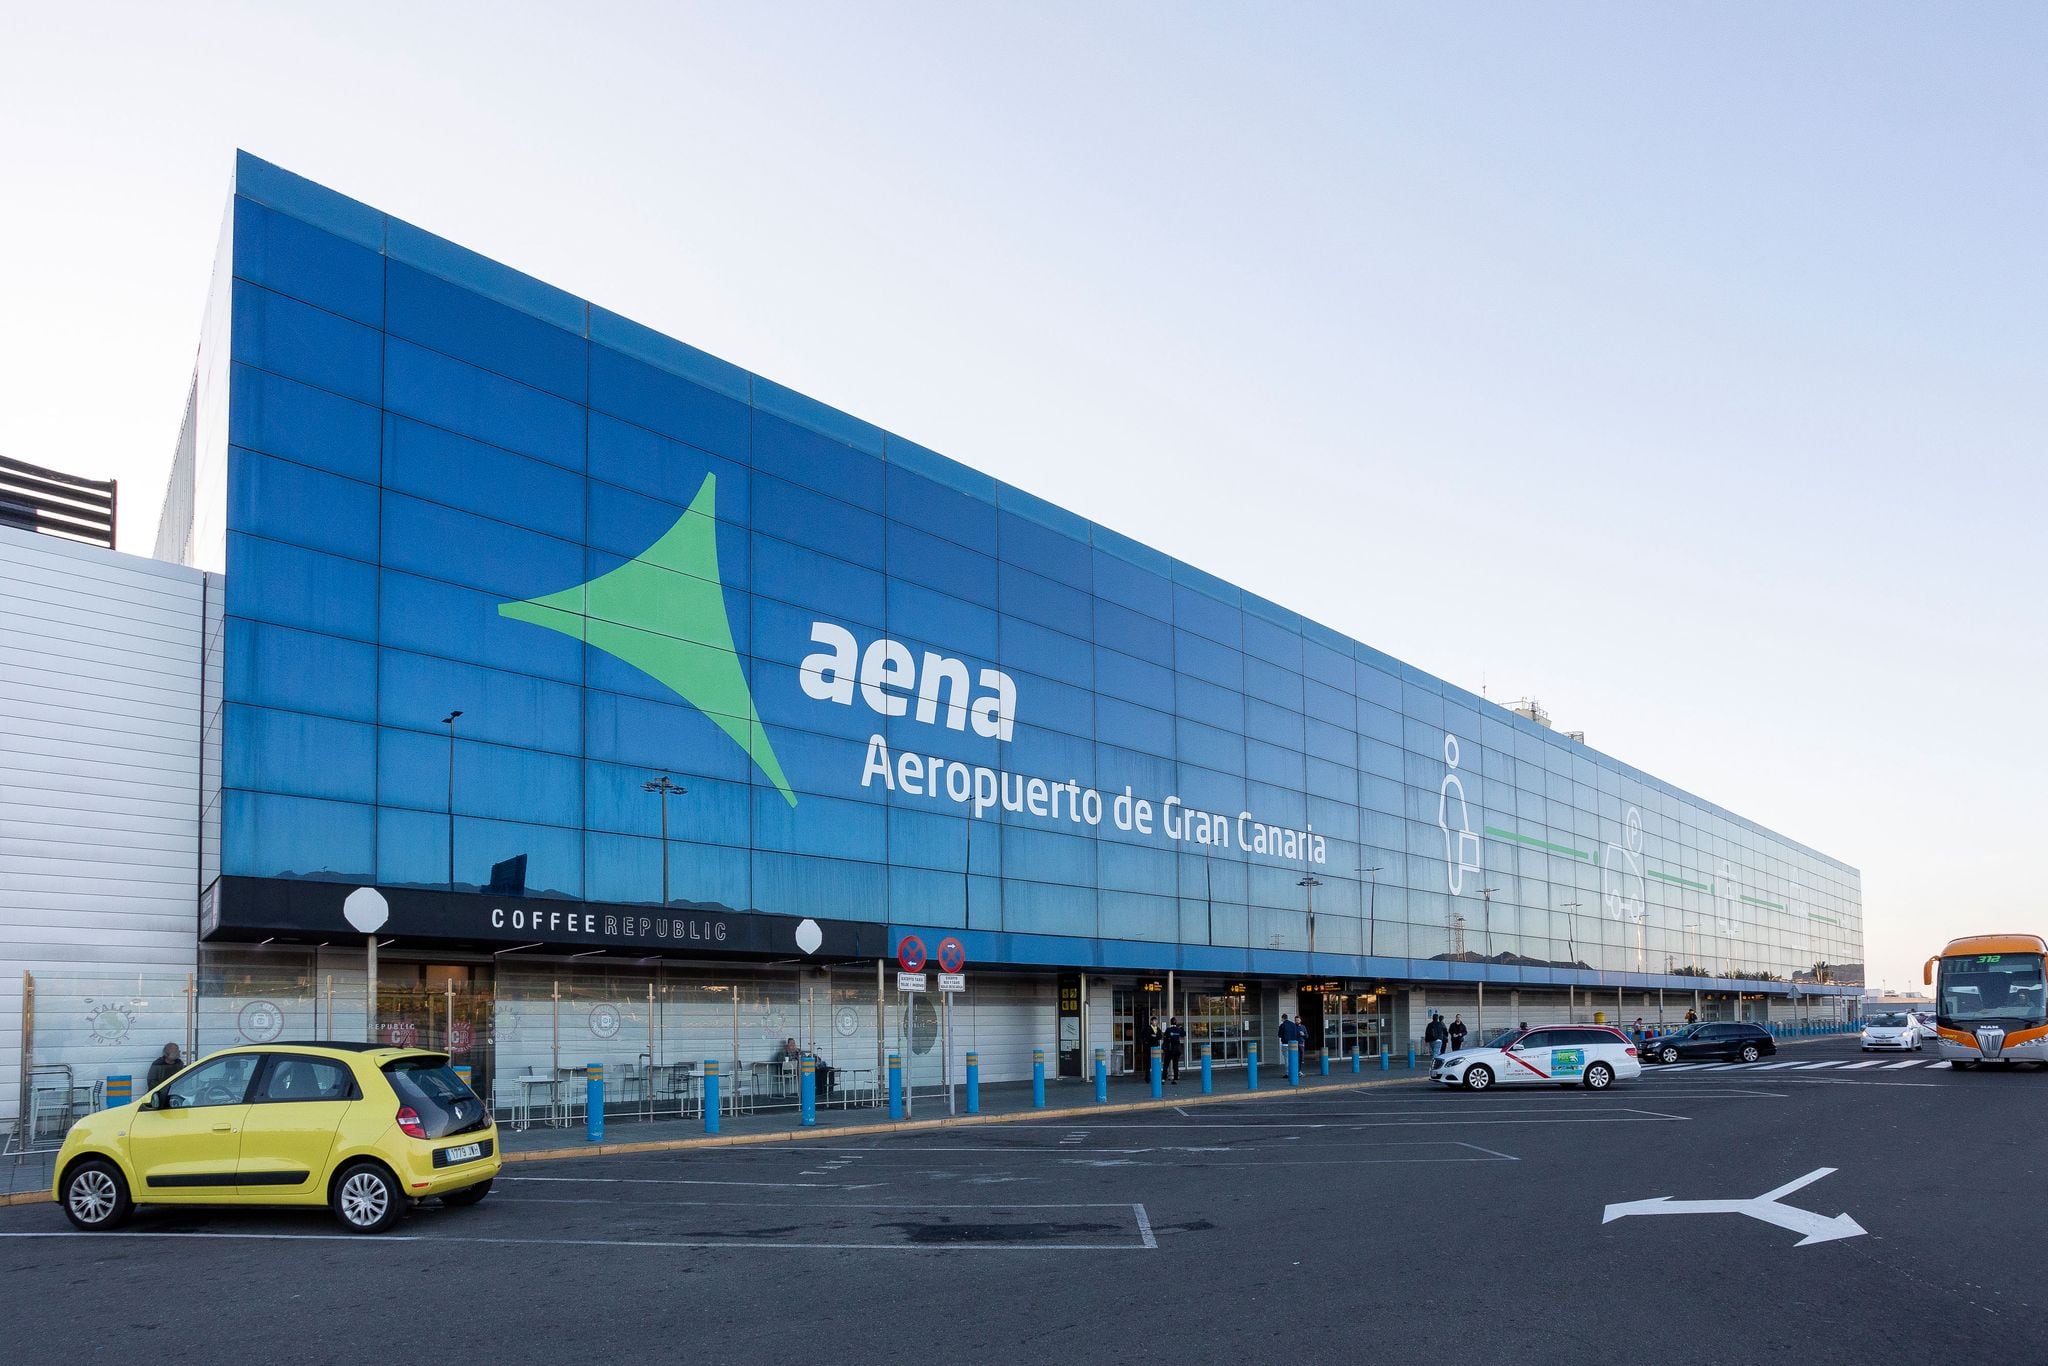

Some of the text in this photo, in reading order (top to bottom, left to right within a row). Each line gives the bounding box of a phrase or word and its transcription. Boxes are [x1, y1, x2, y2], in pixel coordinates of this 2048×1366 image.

[800, 622, 1017, 742] aena
[861, 734, 1326, 865] Aeropuerto de Gran Canaria
[492, 908, 726, 940] COFFEE REPUBLIC
[1976, 955, 2000, 963] 312
[451, 1030, 469, 1044] CR
[451, 1147, 467, 1159] 1779
